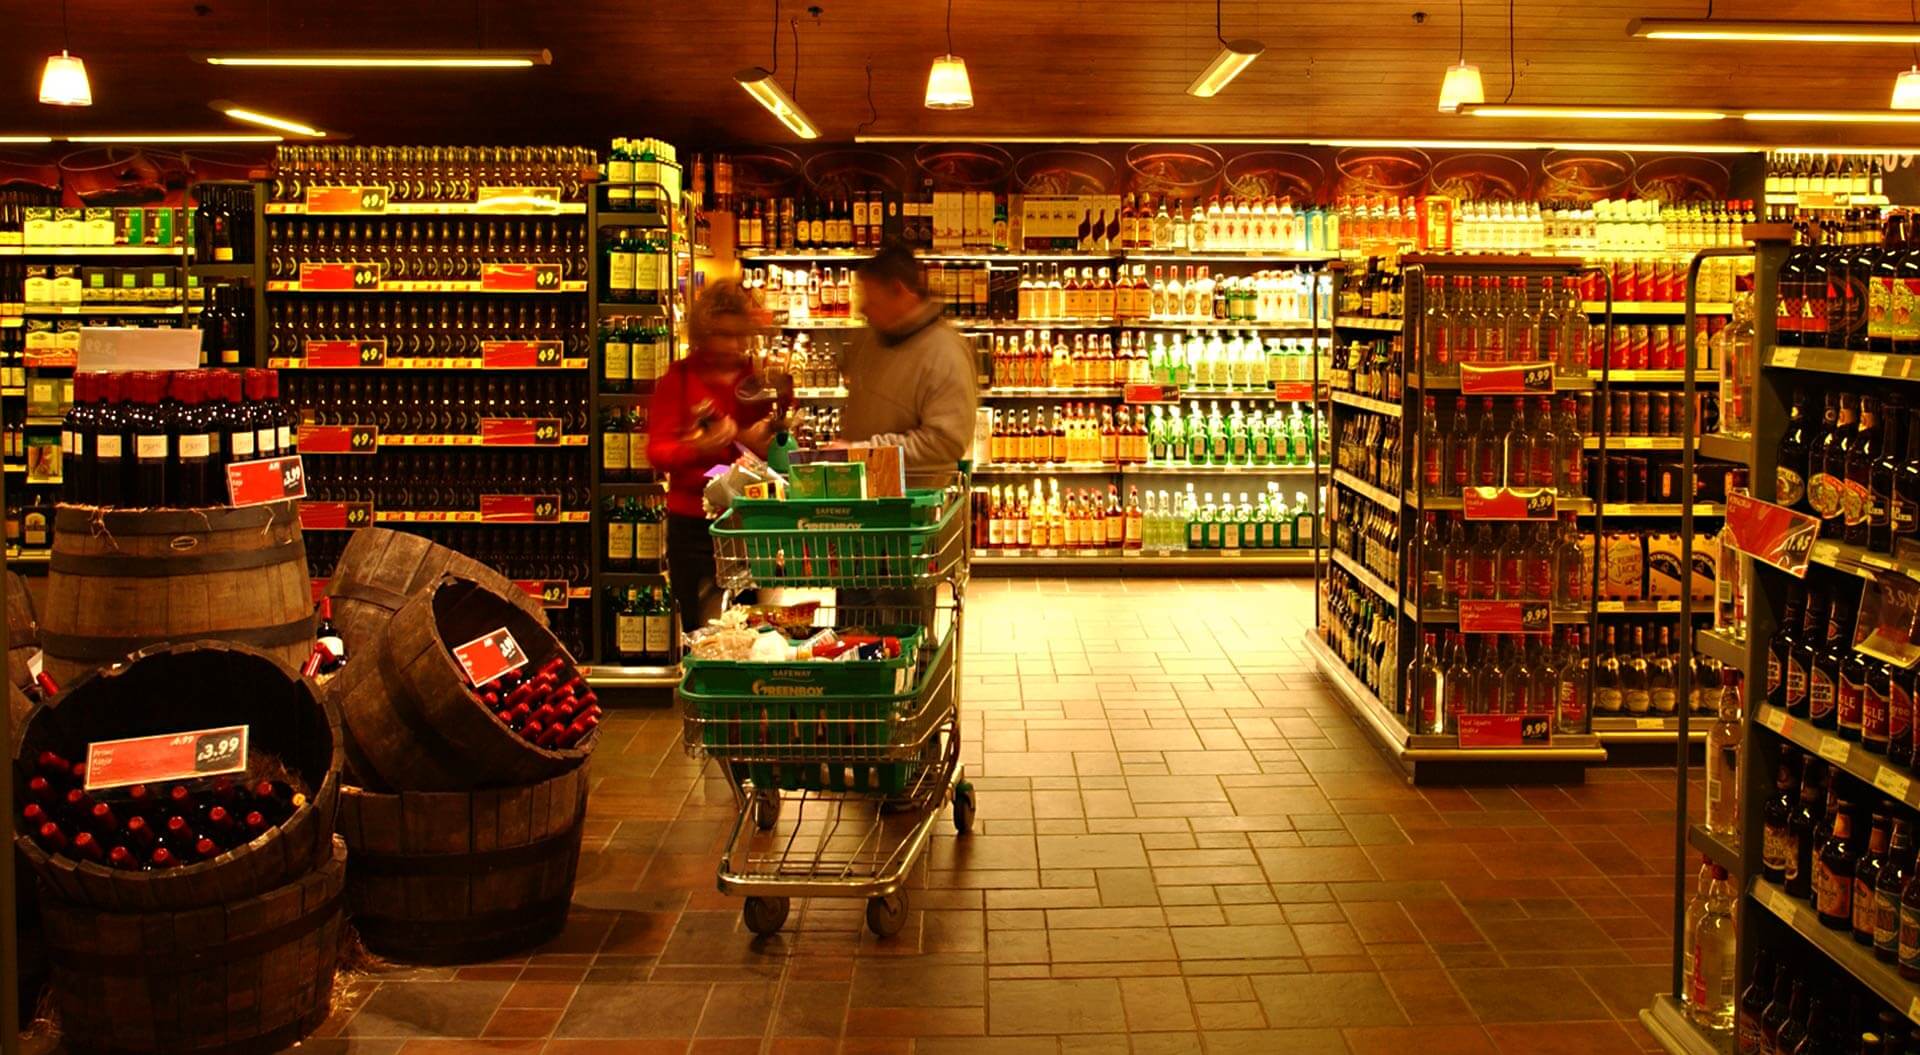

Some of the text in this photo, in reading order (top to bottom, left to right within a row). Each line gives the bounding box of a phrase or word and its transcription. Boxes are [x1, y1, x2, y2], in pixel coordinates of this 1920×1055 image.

[772, 669, 811, 677] SAFEWAY
[752, 679, 824, 696] GREENBOX
[197, 737, 239, 761] £3.99
